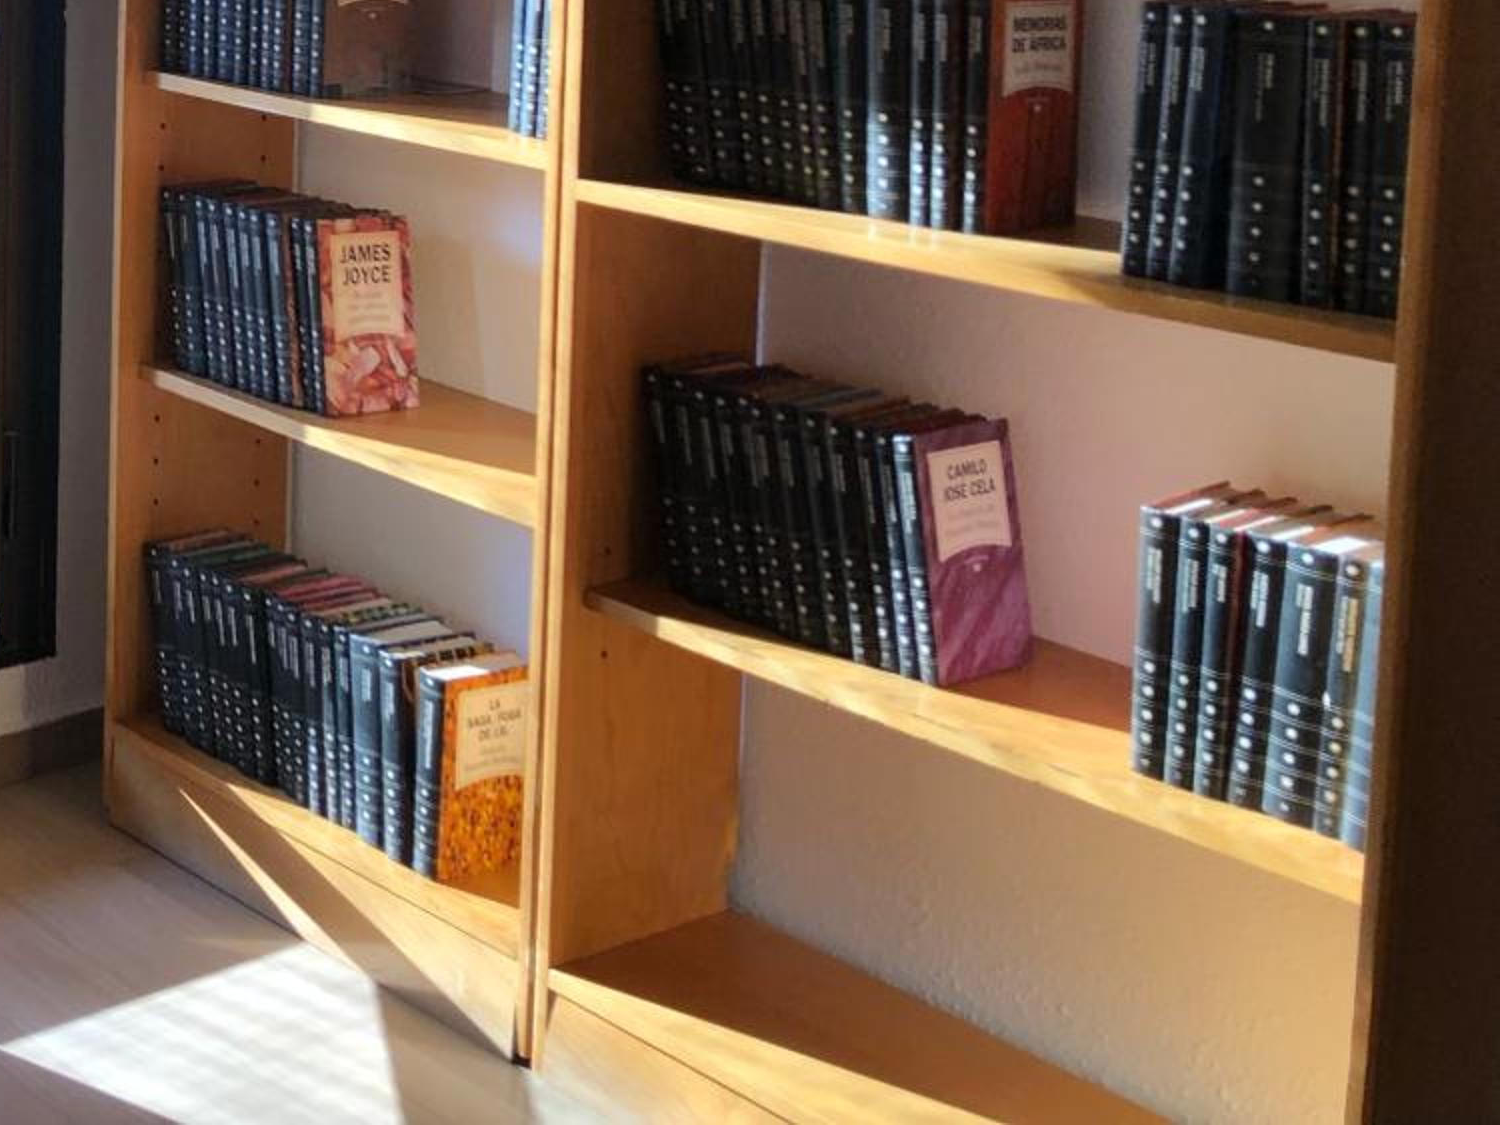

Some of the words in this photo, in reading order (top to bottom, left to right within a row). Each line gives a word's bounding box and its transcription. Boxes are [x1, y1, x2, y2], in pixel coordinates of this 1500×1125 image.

[1013, 15, 1067, 32] MEMORIAS
[1012, 37, 1025, 53] DE
[340, 242, 391, 263] JAMES
[342, 265, 391, 285] JOYCE
[947, 459, 988, 480] CAMILO
[970, 477, 996, 496] CELA
